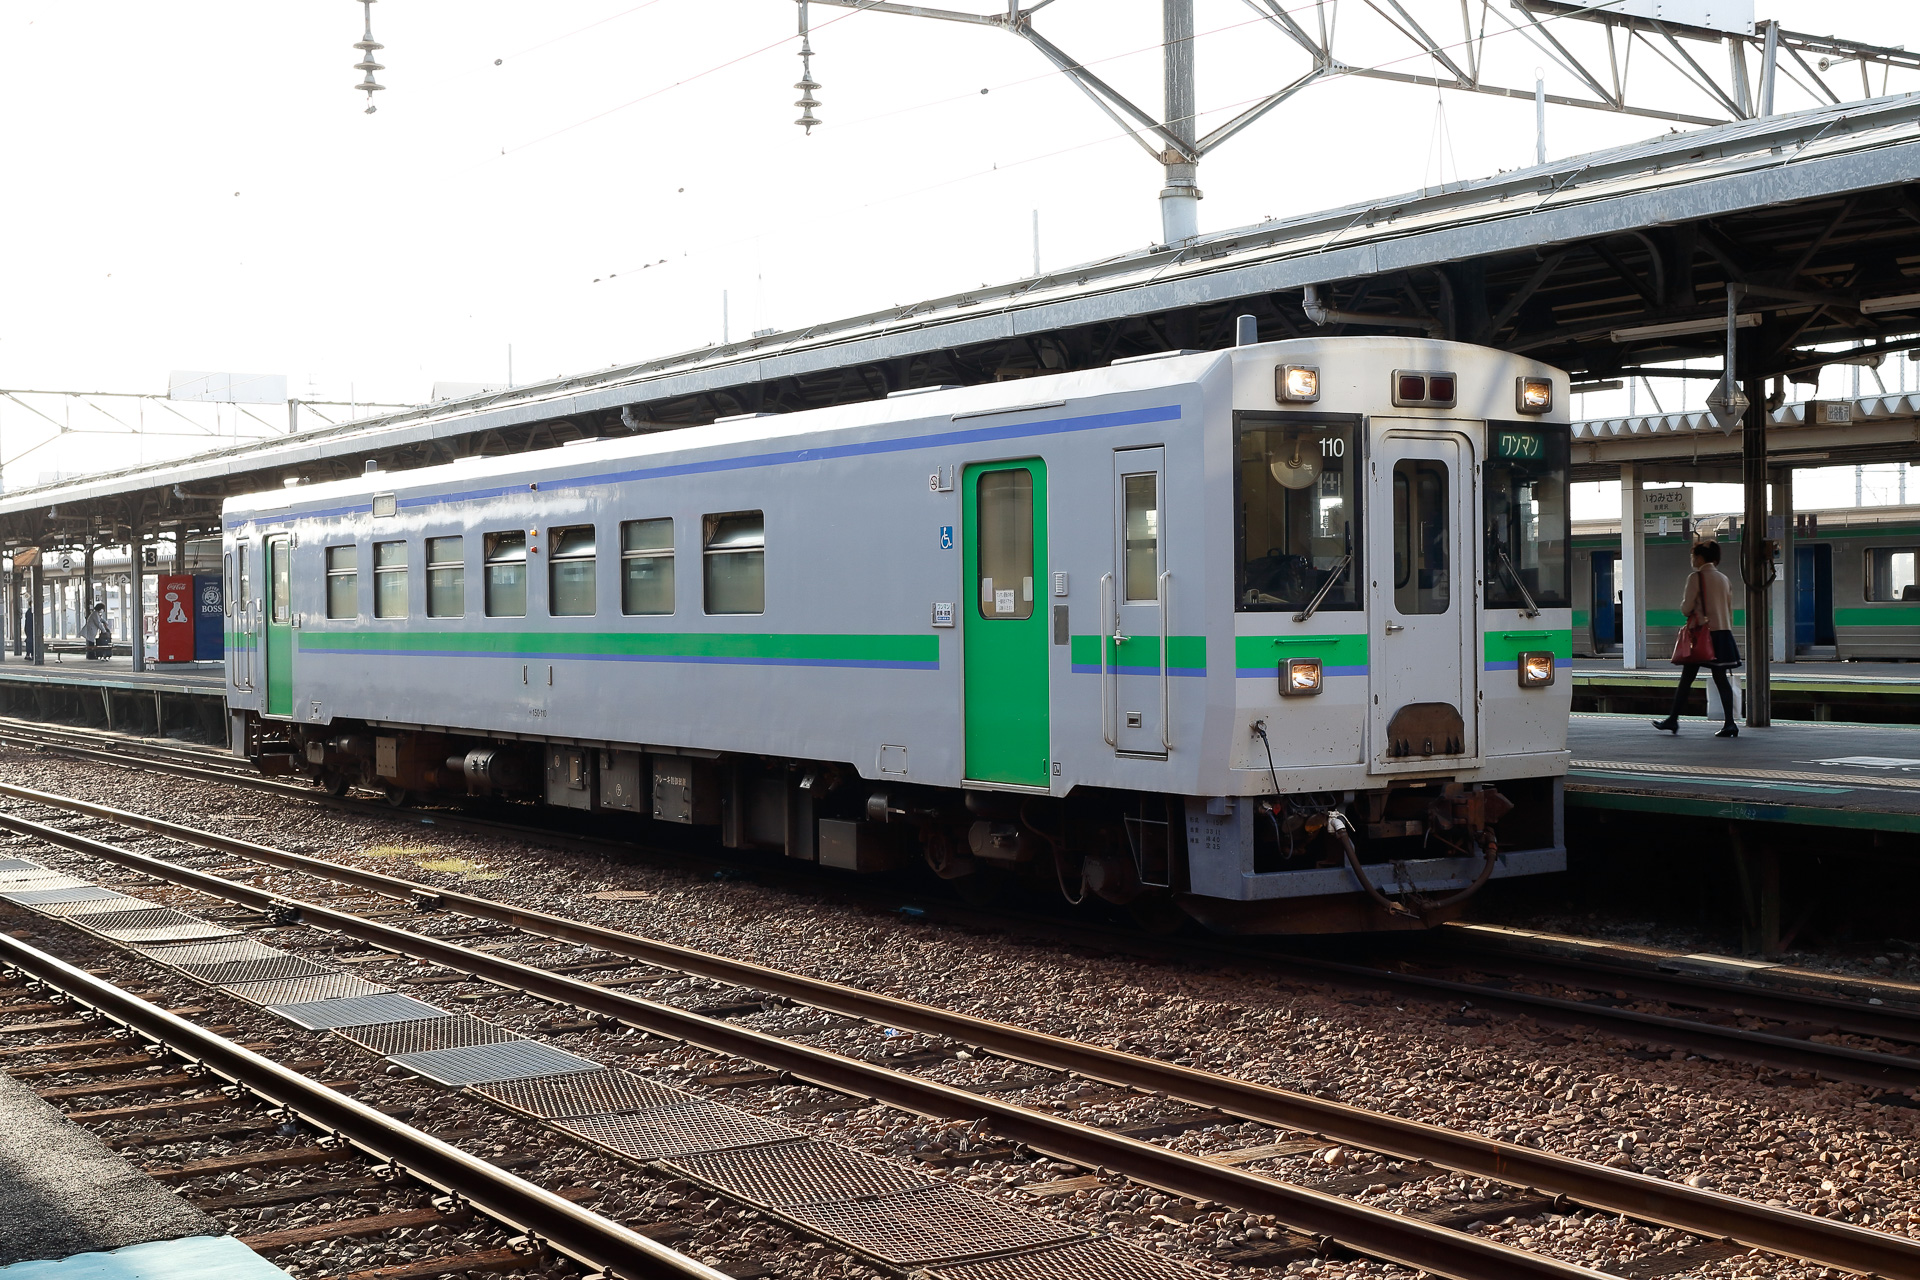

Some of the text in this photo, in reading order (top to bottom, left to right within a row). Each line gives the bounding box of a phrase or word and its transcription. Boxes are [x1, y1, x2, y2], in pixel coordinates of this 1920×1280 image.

[1319, 437, 1345, 458] 110
[1502, 436, 1539, 456] ワンマン
[147, 551, 155, 564] 3
[62, 559, 70, 568] 2
[3, 573, 10, 582] 4
[202, 605, 223, 613] BOSS
